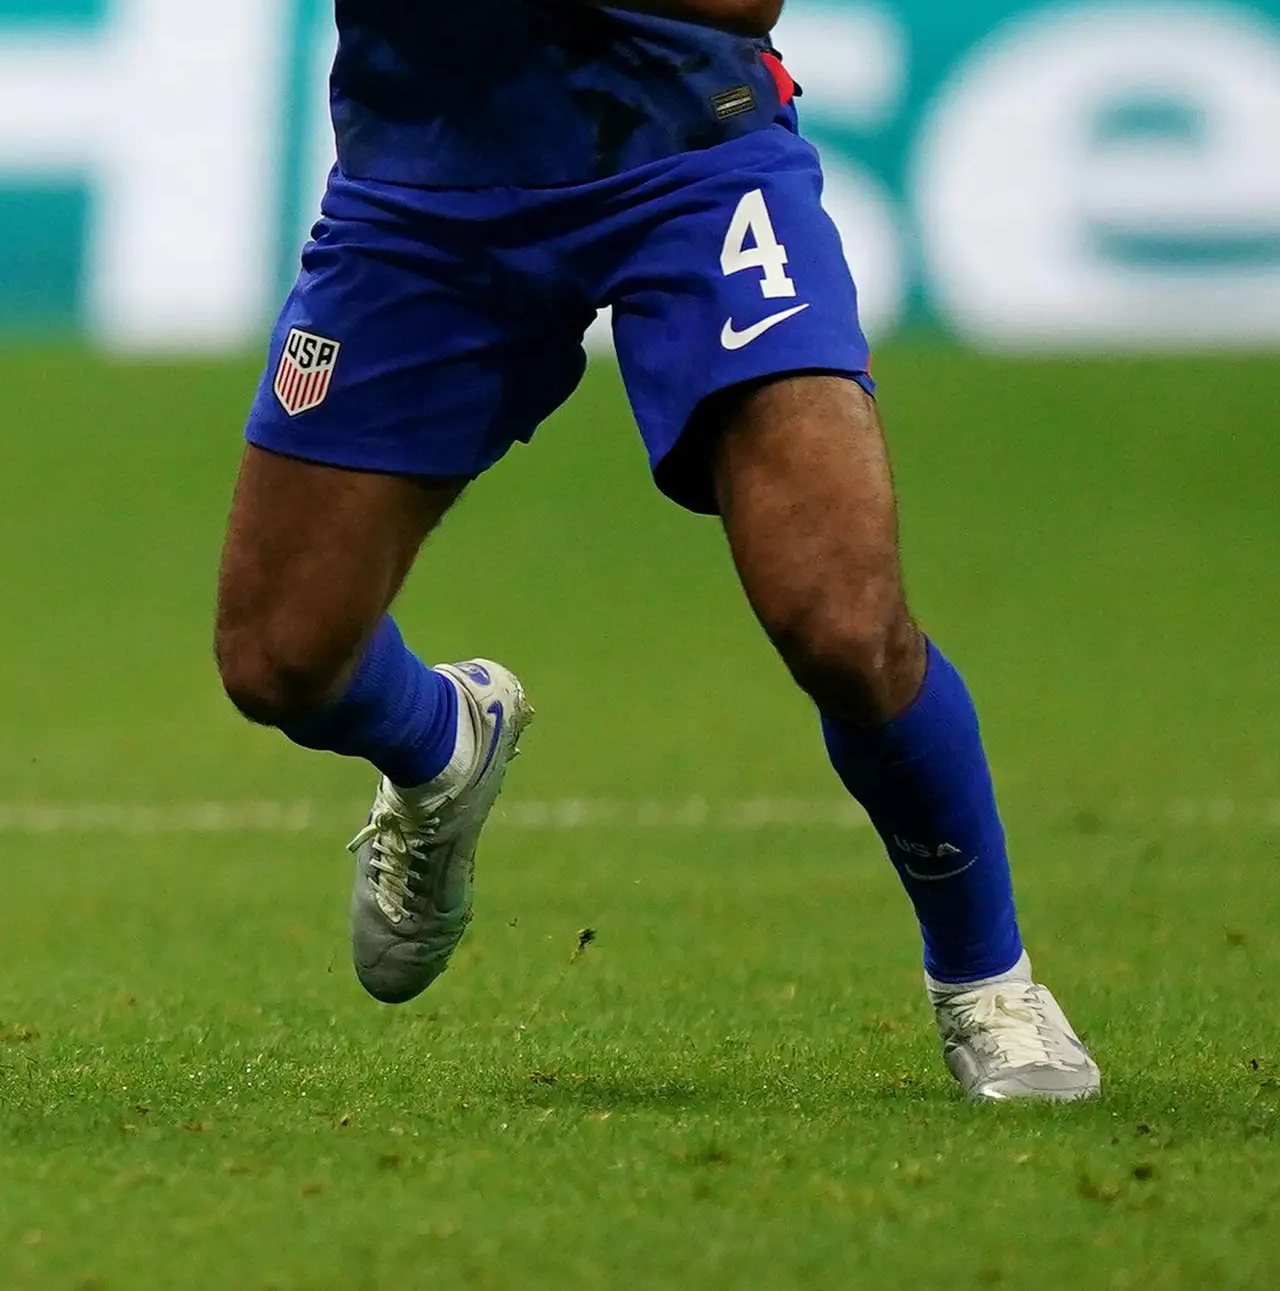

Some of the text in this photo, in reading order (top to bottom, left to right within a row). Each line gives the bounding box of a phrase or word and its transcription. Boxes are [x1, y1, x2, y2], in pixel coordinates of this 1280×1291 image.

[719, 188, 797, 299] 4
[287, 332, 336, 369] USA
[893, 833, 962, 858] USA
